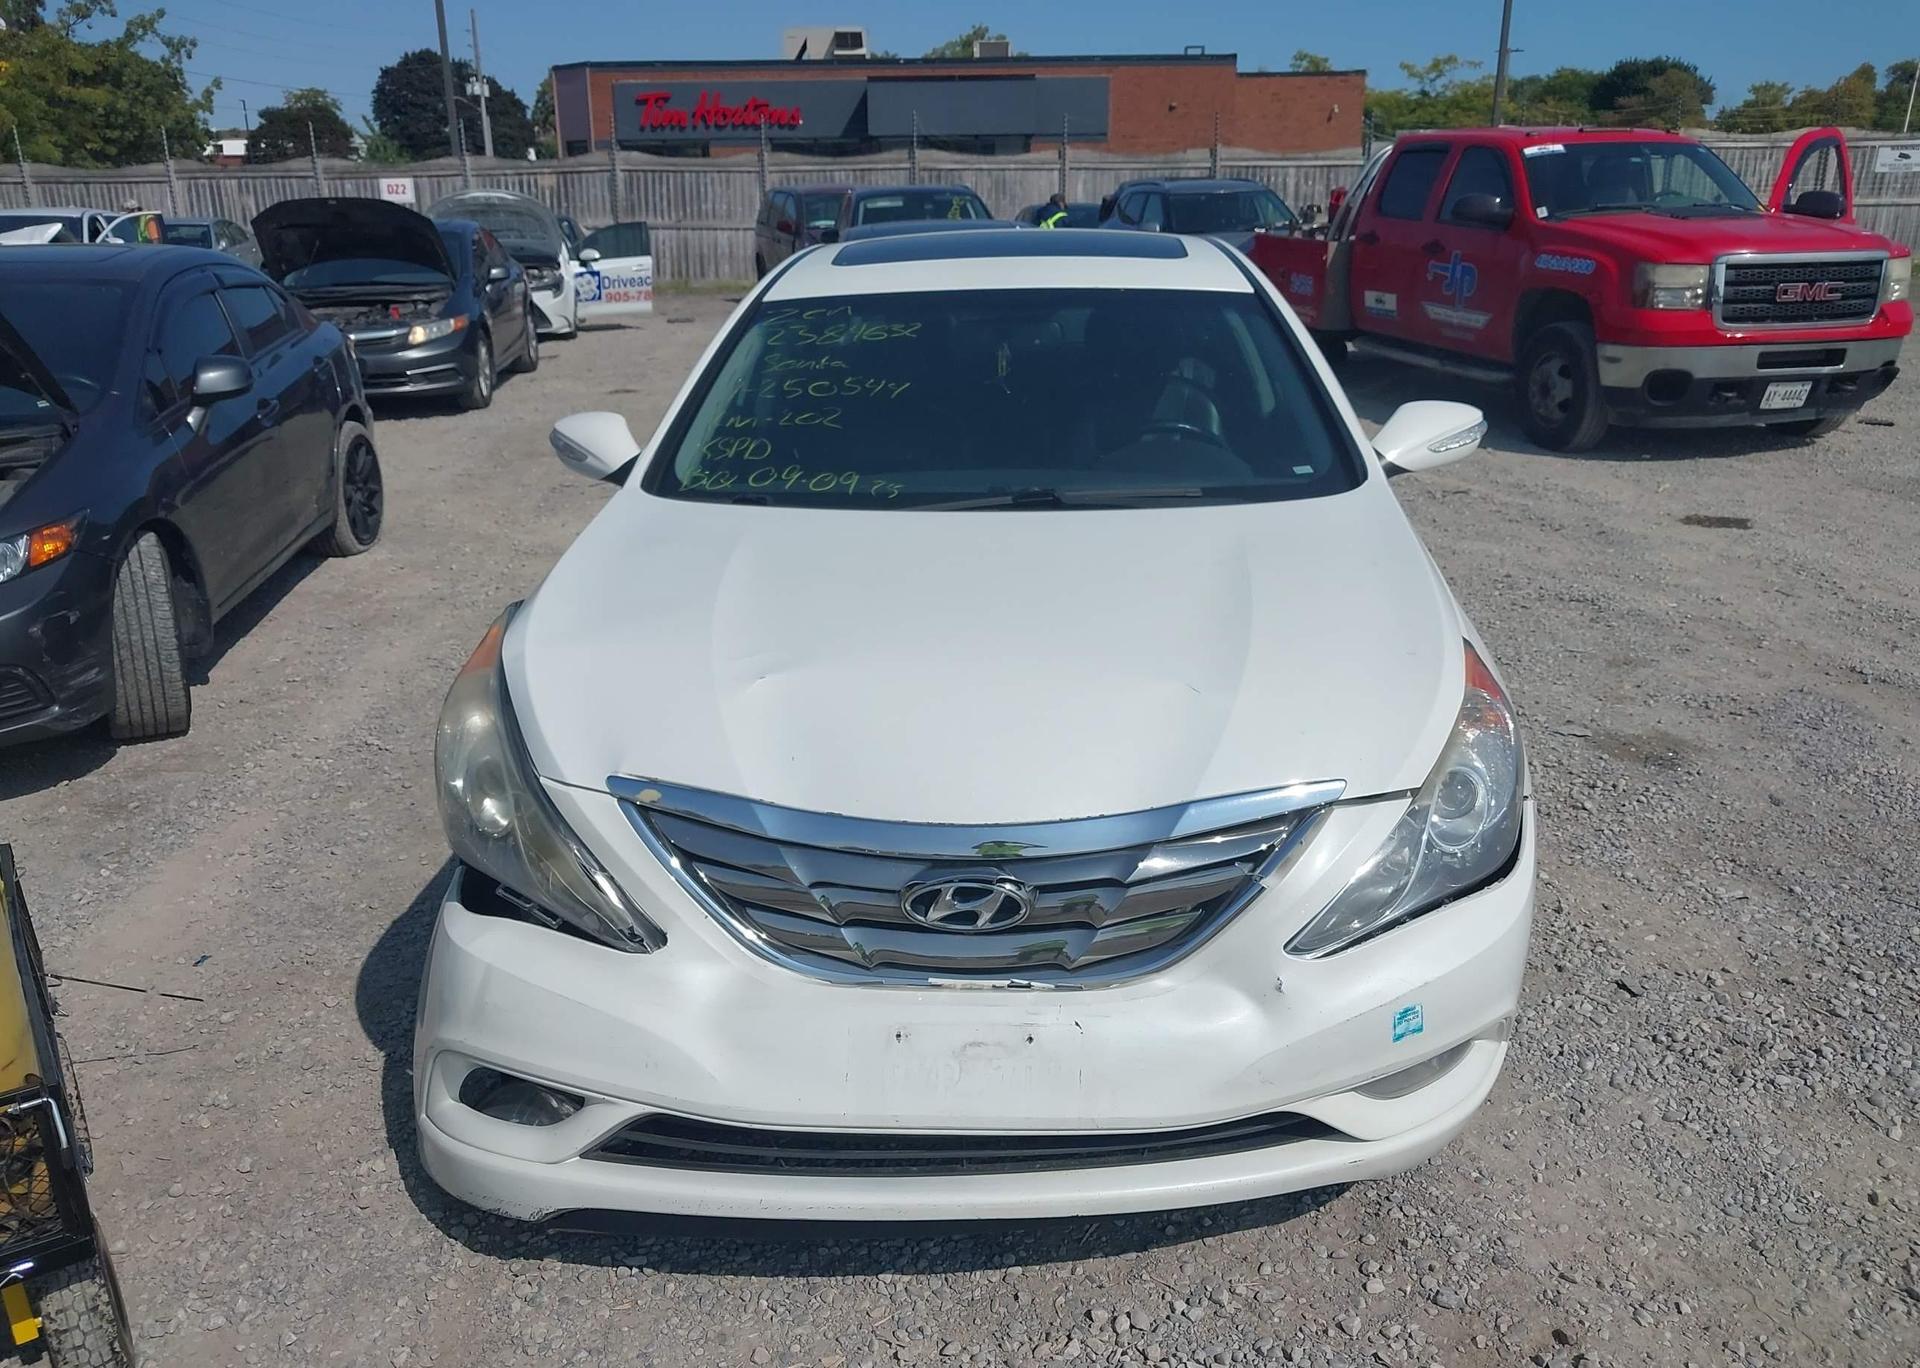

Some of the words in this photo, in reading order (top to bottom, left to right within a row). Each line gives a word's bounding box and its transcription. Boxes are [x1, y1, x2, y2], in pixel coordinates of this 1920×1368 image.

[635, 91, 689, 129] Tim
[693, 90, 803, 129] Hortons
[1776, 281, 1844, 302] GMC
